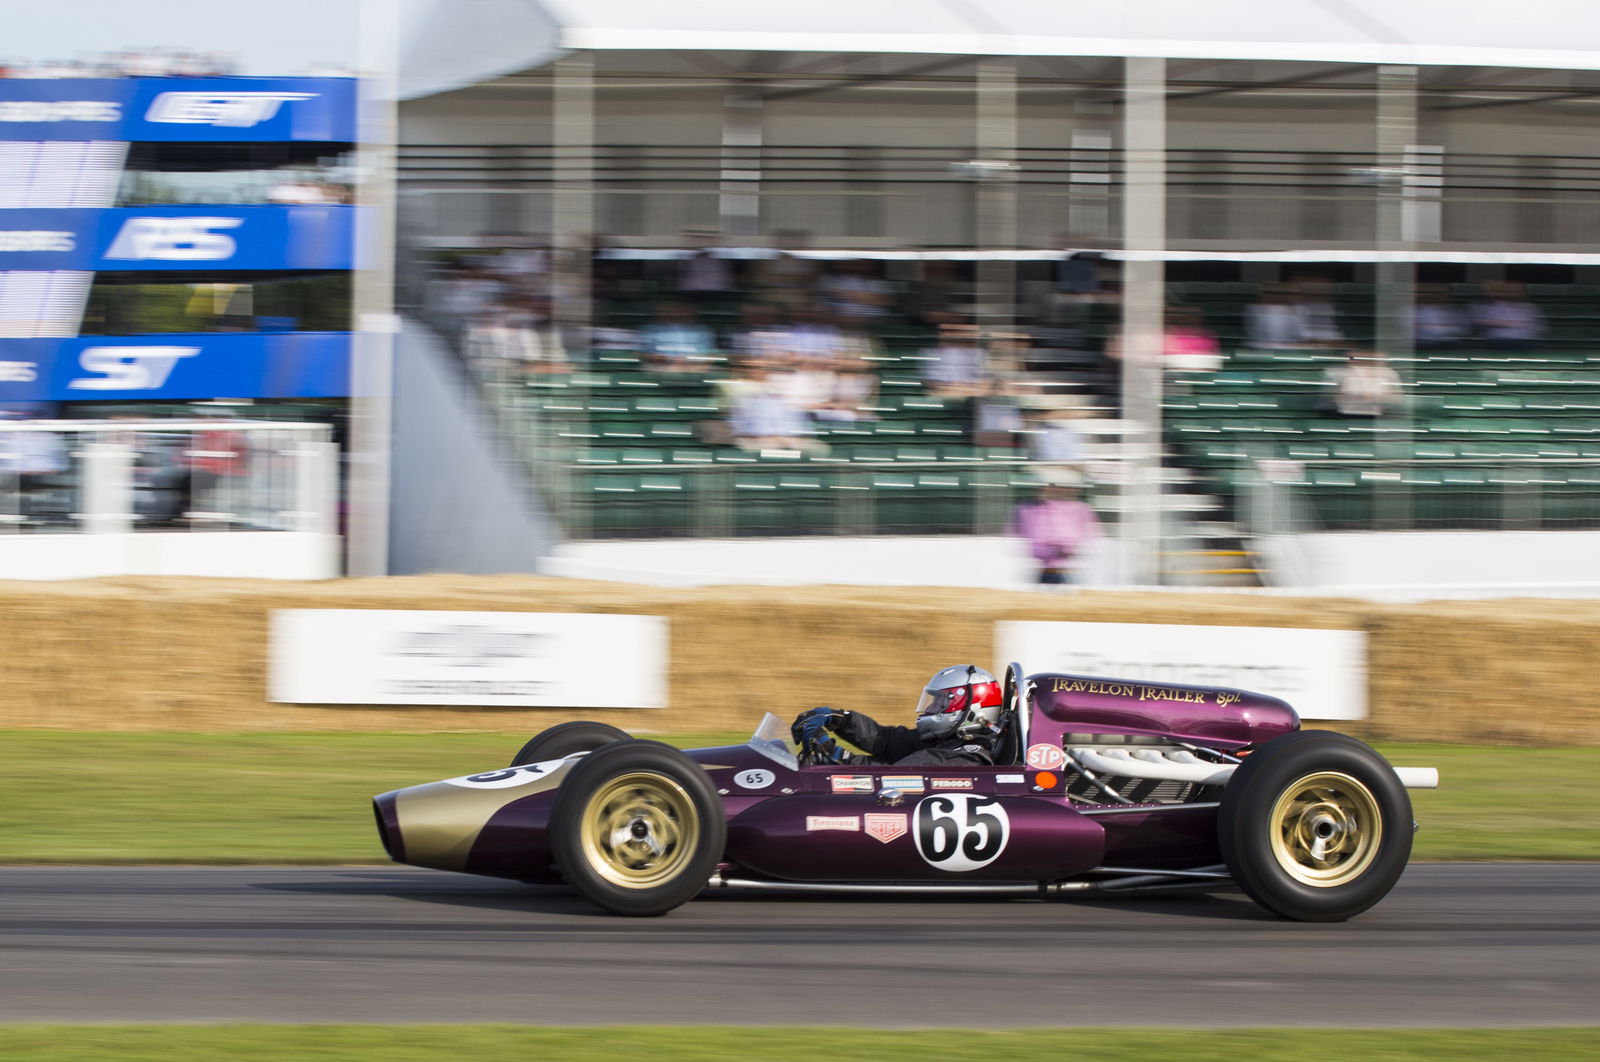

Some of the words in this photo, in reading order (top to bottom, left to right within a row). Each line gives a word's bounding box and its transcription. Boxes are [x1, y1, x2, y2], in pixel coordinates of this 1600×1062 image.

[1048, 677, 1134, 697] TRAVELON
[1136, 684, 1213, 704] TRAILER
[1029, 745, 1061, 765] STP
[745, 773, 764, 784] 65
[932, 780, 972, 788] FERODO
[919, 797, 1003, 862] 65
